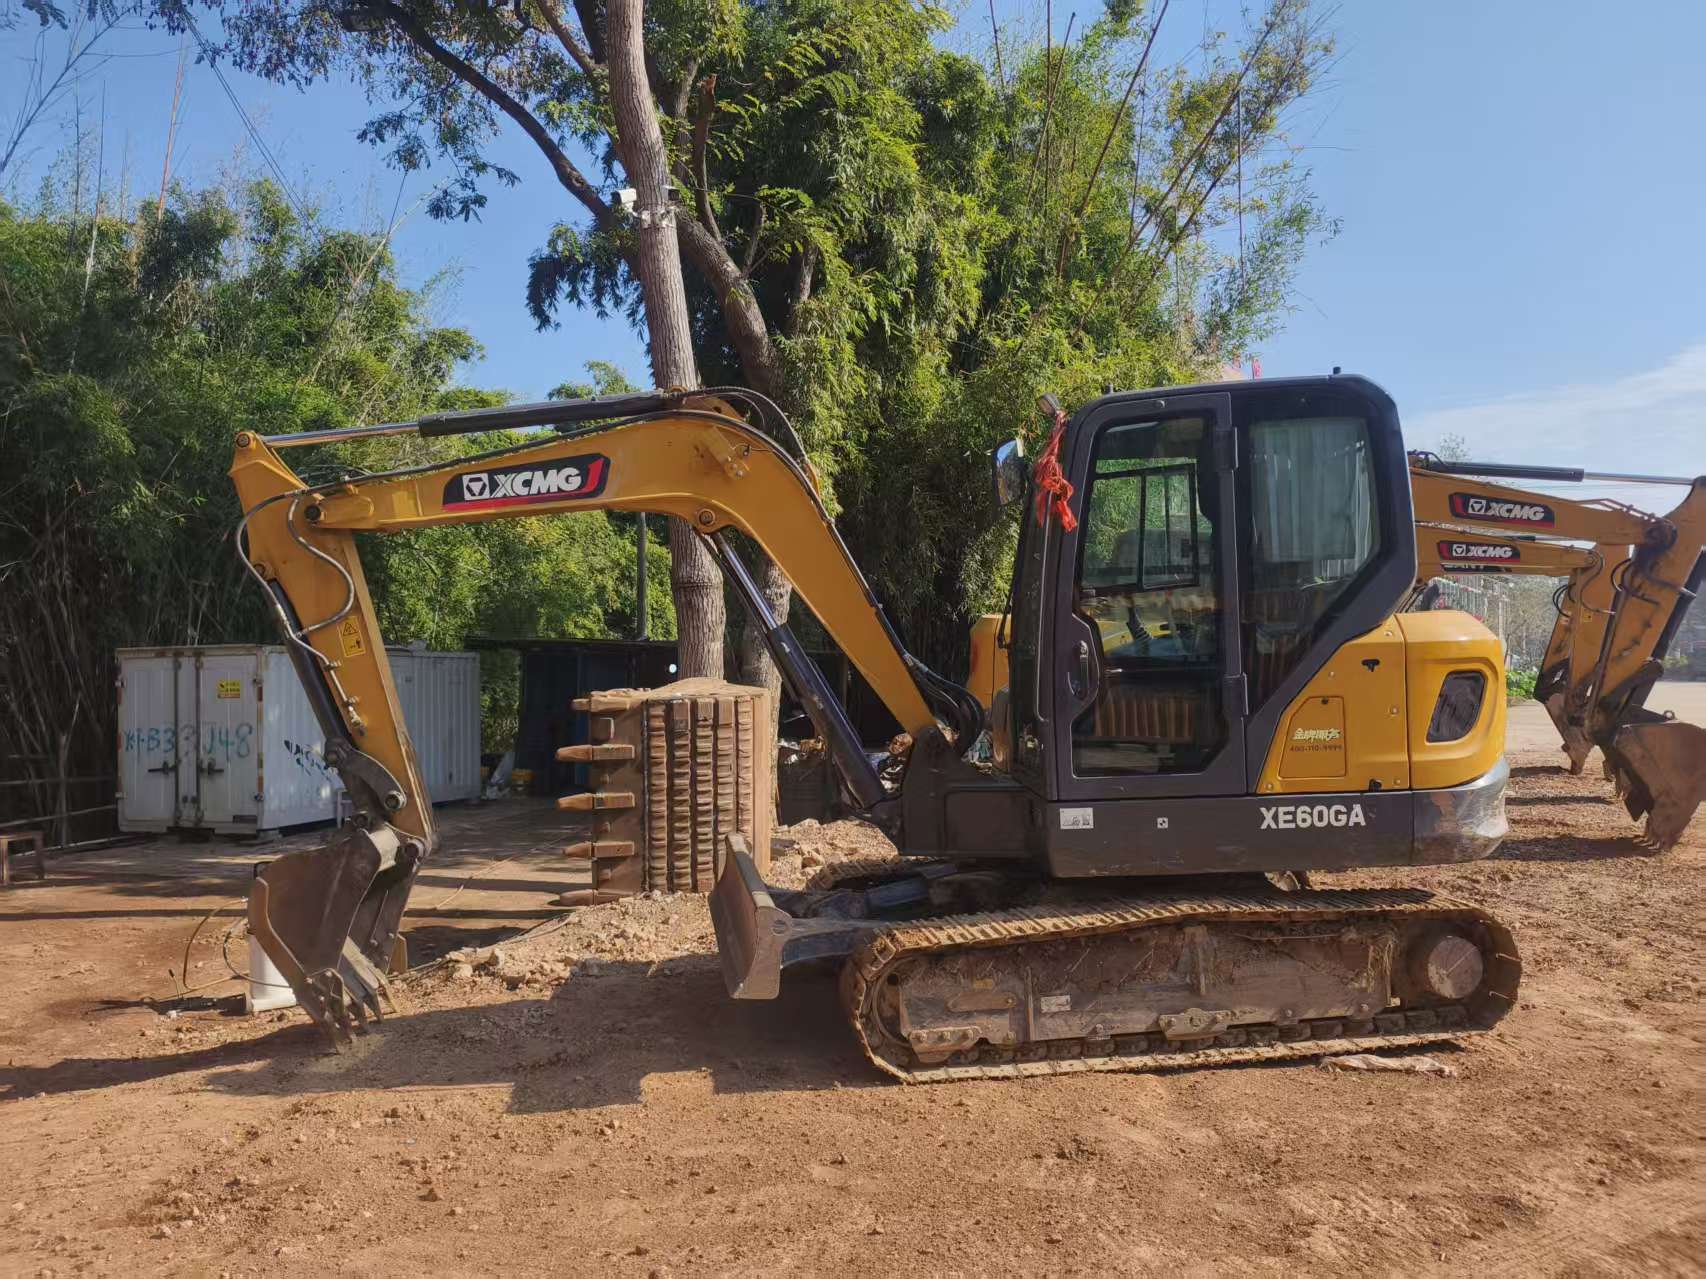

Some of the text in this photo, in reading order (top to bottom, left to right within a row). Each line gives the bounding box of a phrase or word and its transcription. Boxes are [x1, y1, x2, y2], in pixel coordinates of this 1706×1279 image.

[493, 468, 581, 498] XCMG
[1488, 502, 1545, 521] XCMG
[1468, 546, 1513, 558] XCMG
[1260, 804, 1366, 829] XE60GA
